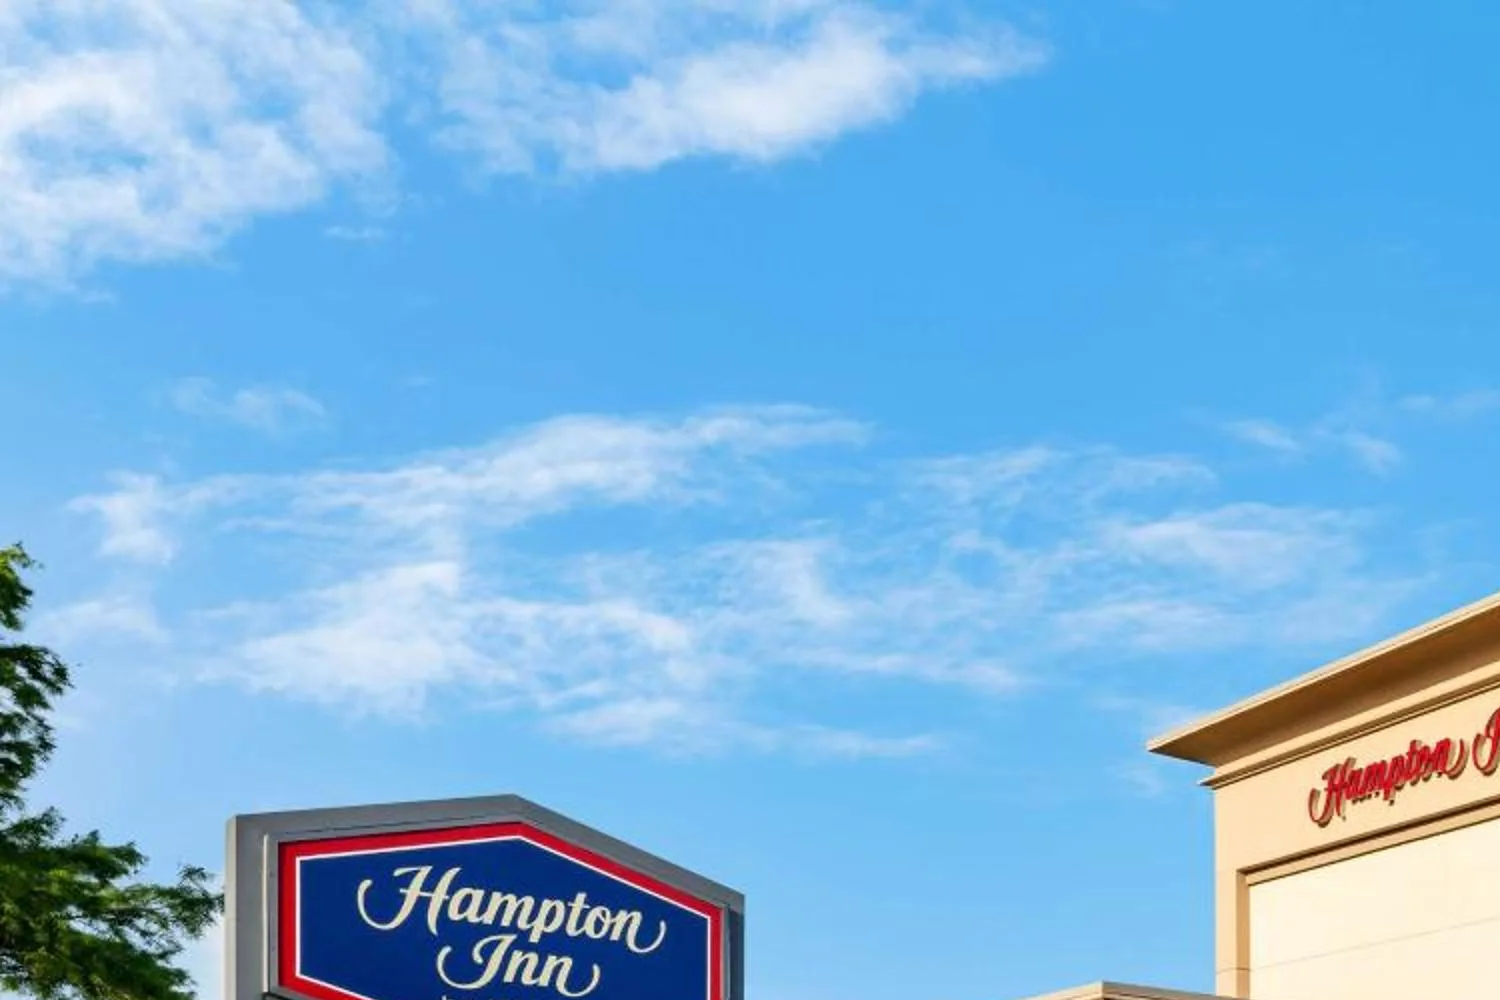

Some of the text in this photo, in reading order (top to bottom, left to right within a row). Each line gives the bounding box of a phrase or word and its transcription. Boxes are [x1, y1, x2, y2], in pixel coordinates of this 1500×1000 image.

[1308, 738, 1467, 825] Hampton
[357, 865, 667, 954] Hampton
[436, 934, 601, 998] Inn
